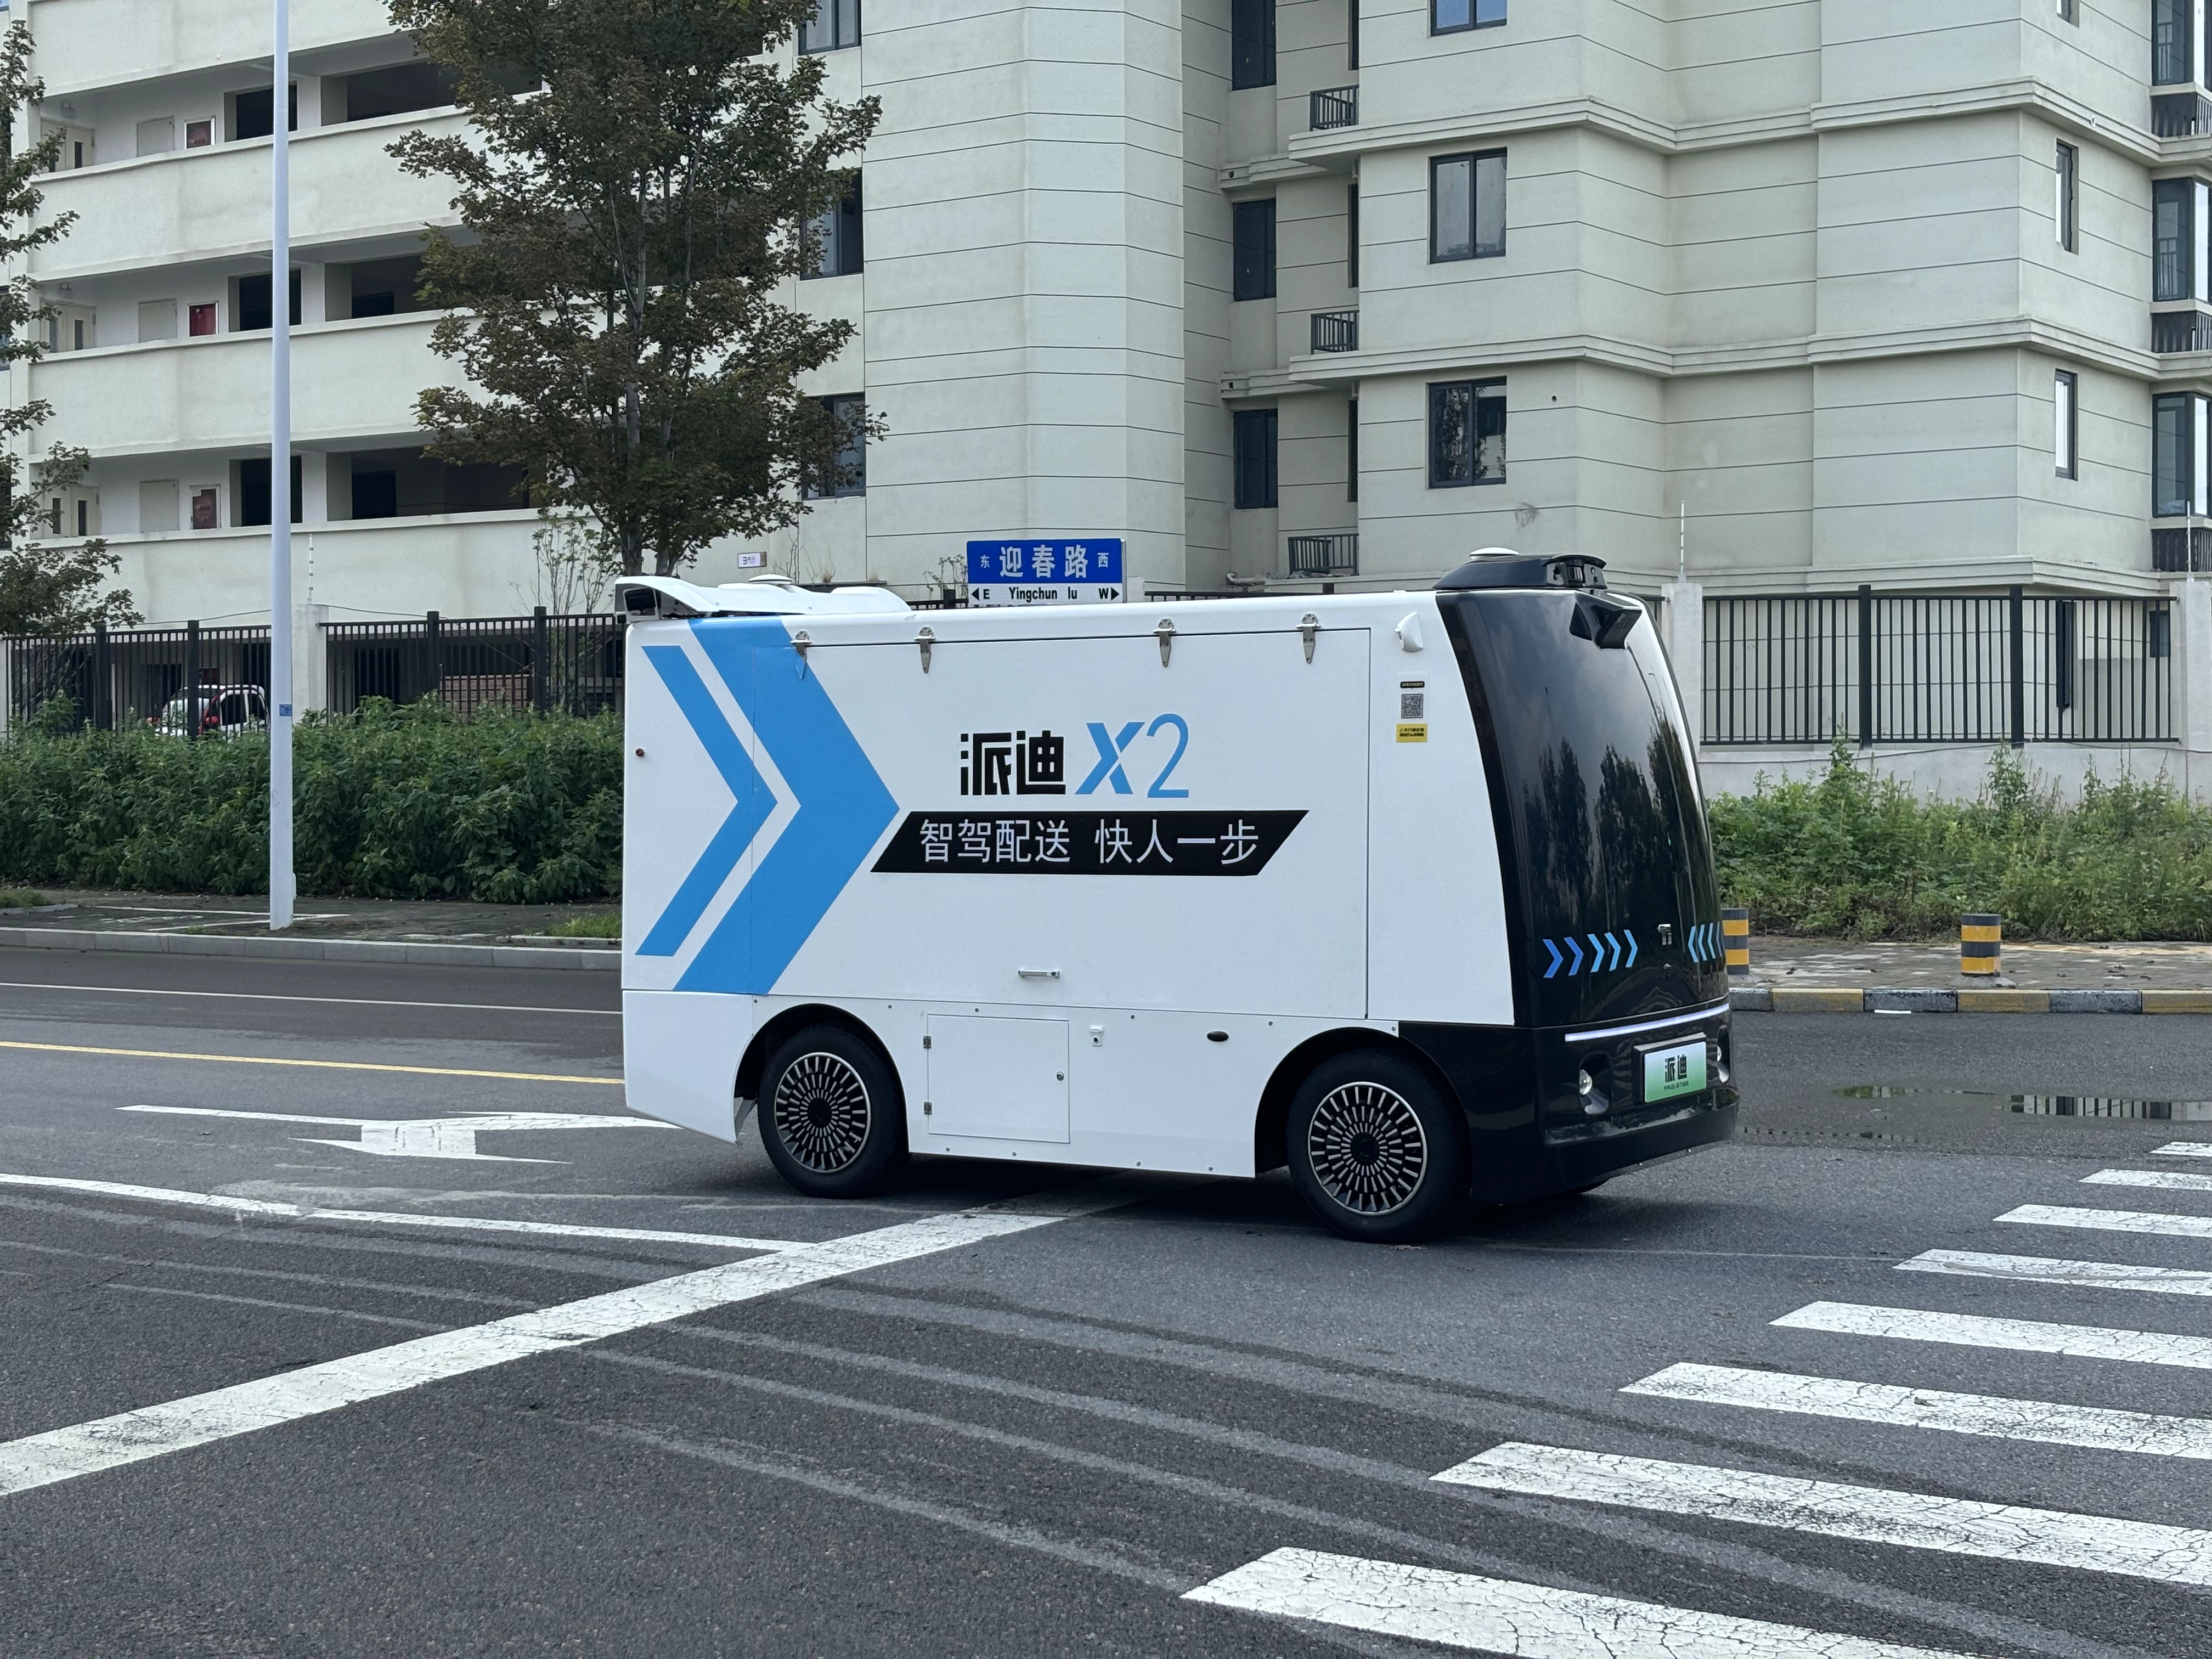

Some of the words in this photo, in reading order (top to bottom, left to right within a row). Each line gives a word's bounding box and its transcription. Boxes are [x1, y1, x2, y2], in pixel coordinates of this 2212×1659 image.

[980, 554, 990, 569] 东
[999, 544, 1088, 578] 迎春路
[1097, 552, 1109, 568] 西
[983, 589, 990, 600] E
[1008, 586, 1058, 603] Yingchun
[1098, 587, 1109, 600] W
[960, 730, 1066, 796] 派迪
[1075, 713, 1189, 798] X2
[920, 819, 1070, 863] 智驾配送
[1094, 819, 1259, 865] 快人一步
[1664, 1053, 1688, 1083] 派迪
